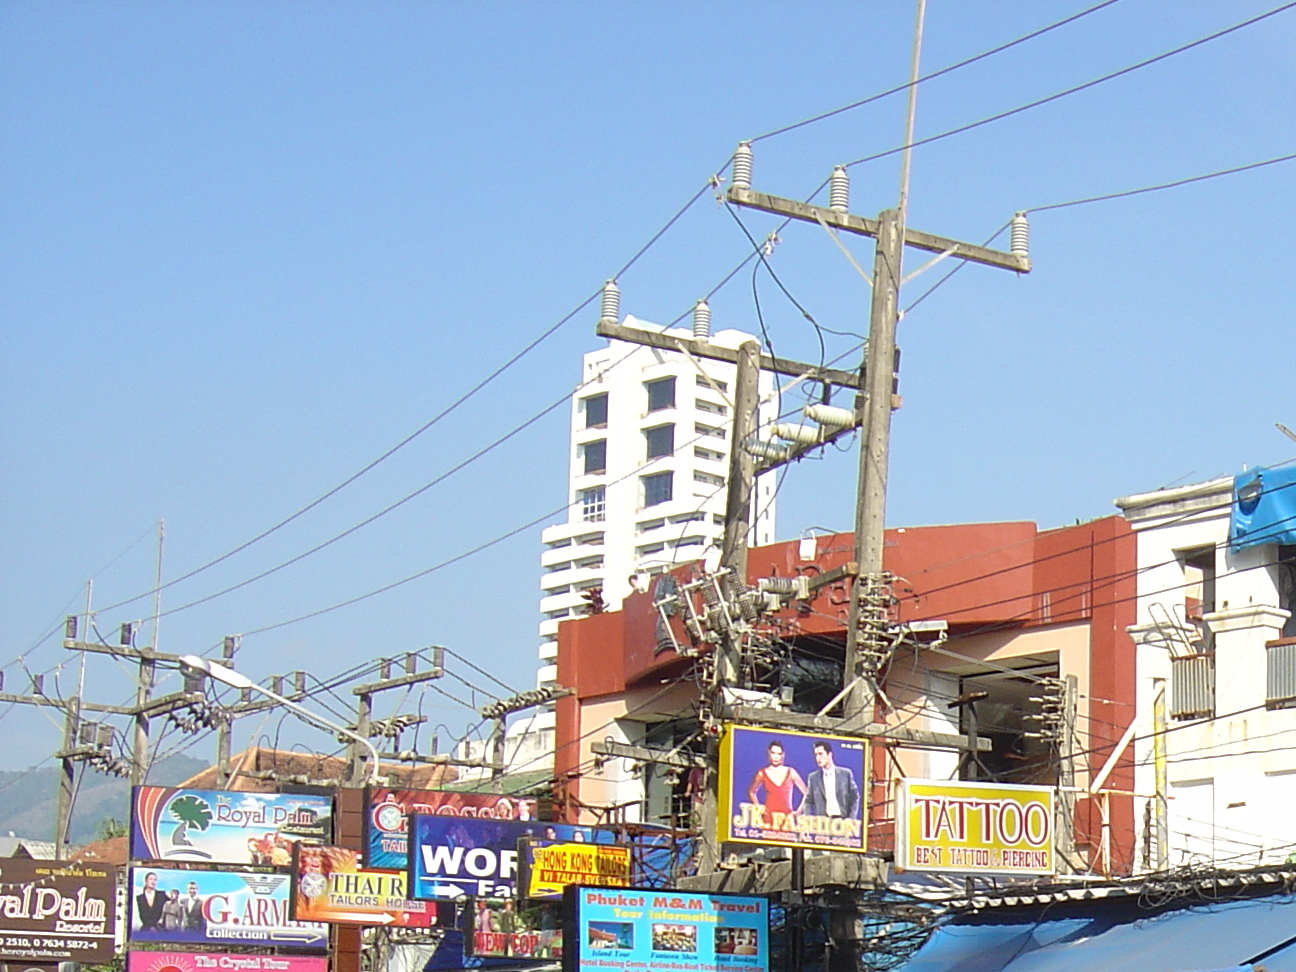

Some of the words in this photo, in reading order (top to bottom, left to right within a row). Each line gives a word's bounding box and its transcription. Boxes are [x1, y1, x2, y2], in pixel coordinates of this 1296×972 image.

[217, 804, 266, 828] Royal
[272, 806, 314, 826] Palm
[915, 797, 1049, 846] TATTOO
[543, 850, 567, 871] HONG
[570, 852, 593, 874] KONG
[916, 847, 943, 865] BEST
[950, 848, 989, 866] TATTOO
[331, 874, 384, 896] THAI
[33, 887, 107, 921] Palm
[330, 894, 379, 906] TAILORS
[586, 893, 645, 907] Phuket
[653, 897, 703, 910] M&M
[711, 900, 761, 914] Travel
[613, 908, 643, 918] Tour
[648, 910, 724, 922] Information
[6, 937, 31, 948] 2510,
[206, 927, 268, 940] Collection
[194, 956, 217, 968] The
